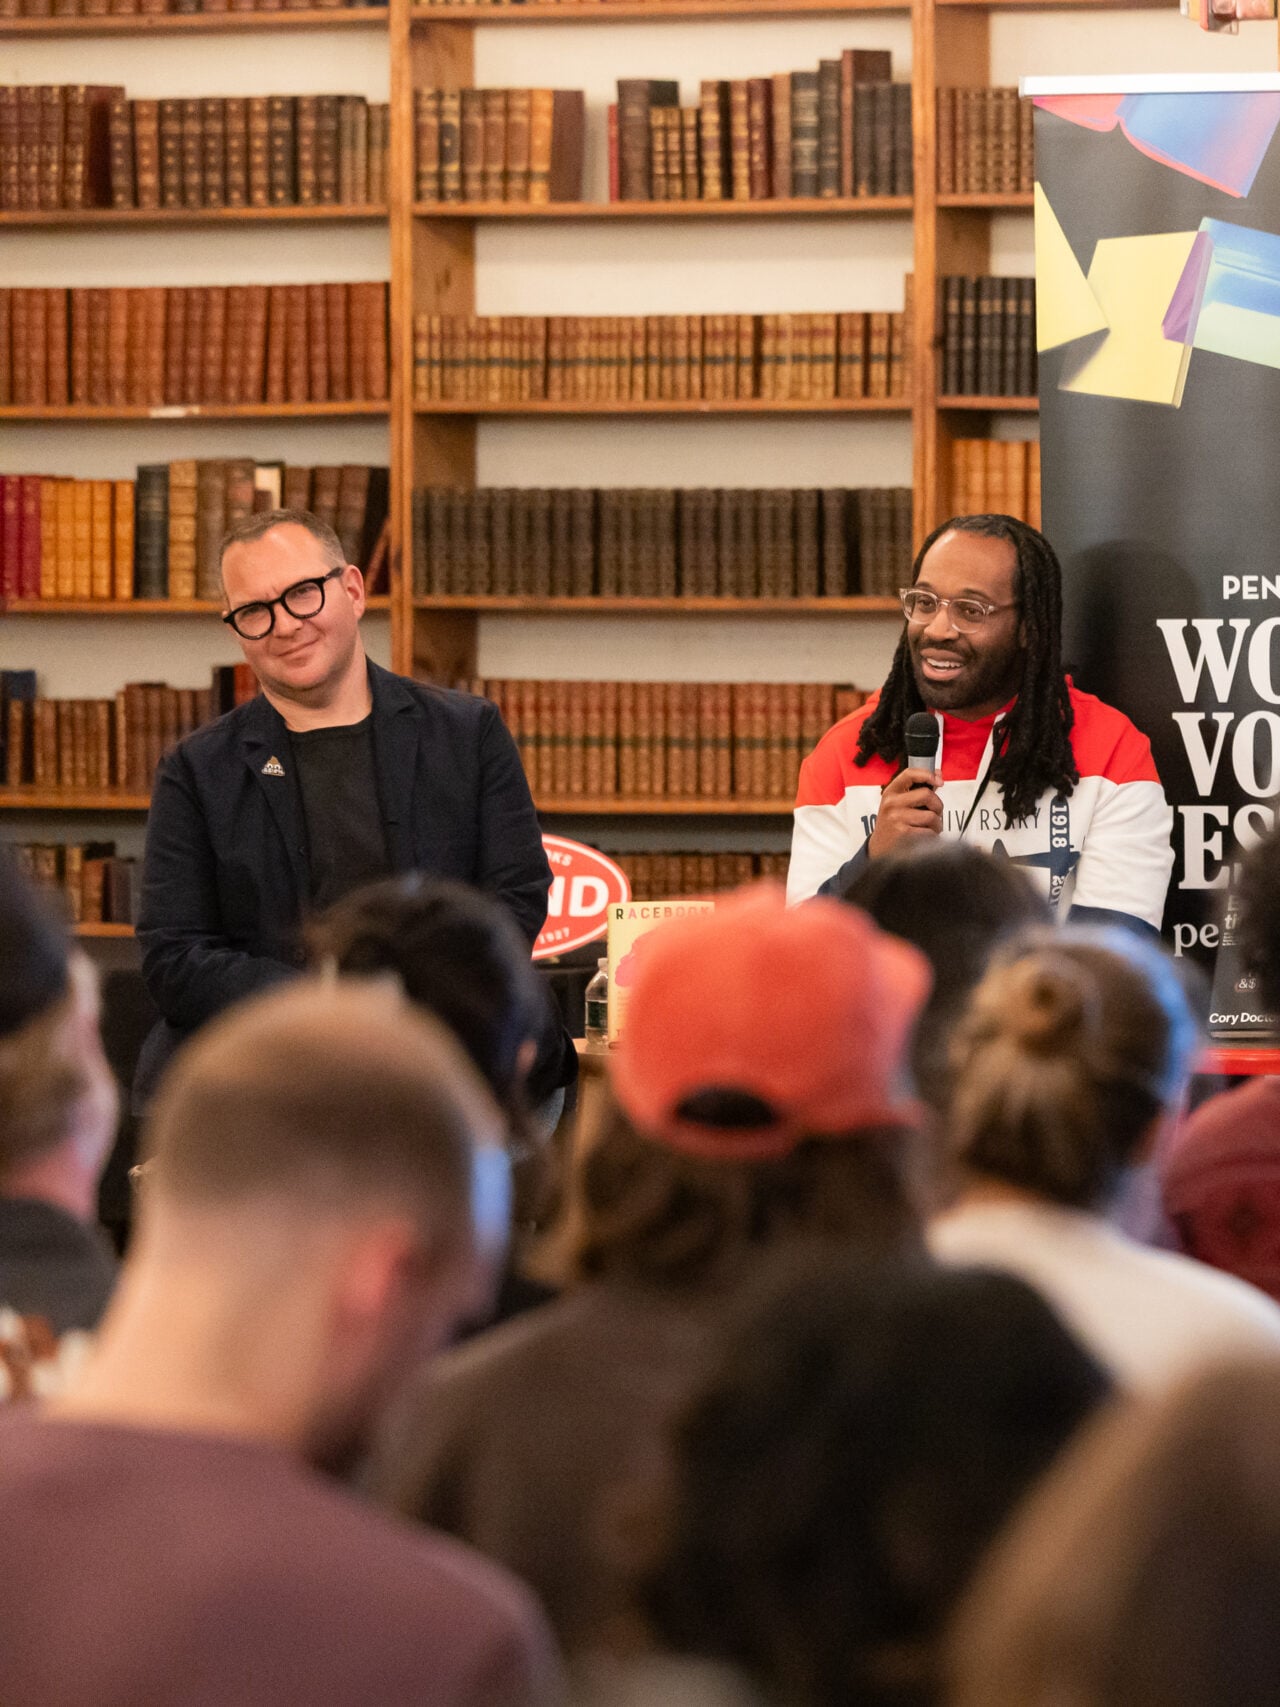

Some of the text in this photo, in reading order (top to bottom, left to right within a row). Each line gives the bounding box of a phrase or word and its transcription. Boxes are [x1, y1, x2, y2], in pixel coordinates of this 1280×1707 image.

[1052, 805, 1067, 848] 1918
[1209, 1012, 1277, 1025] Cory Doct
